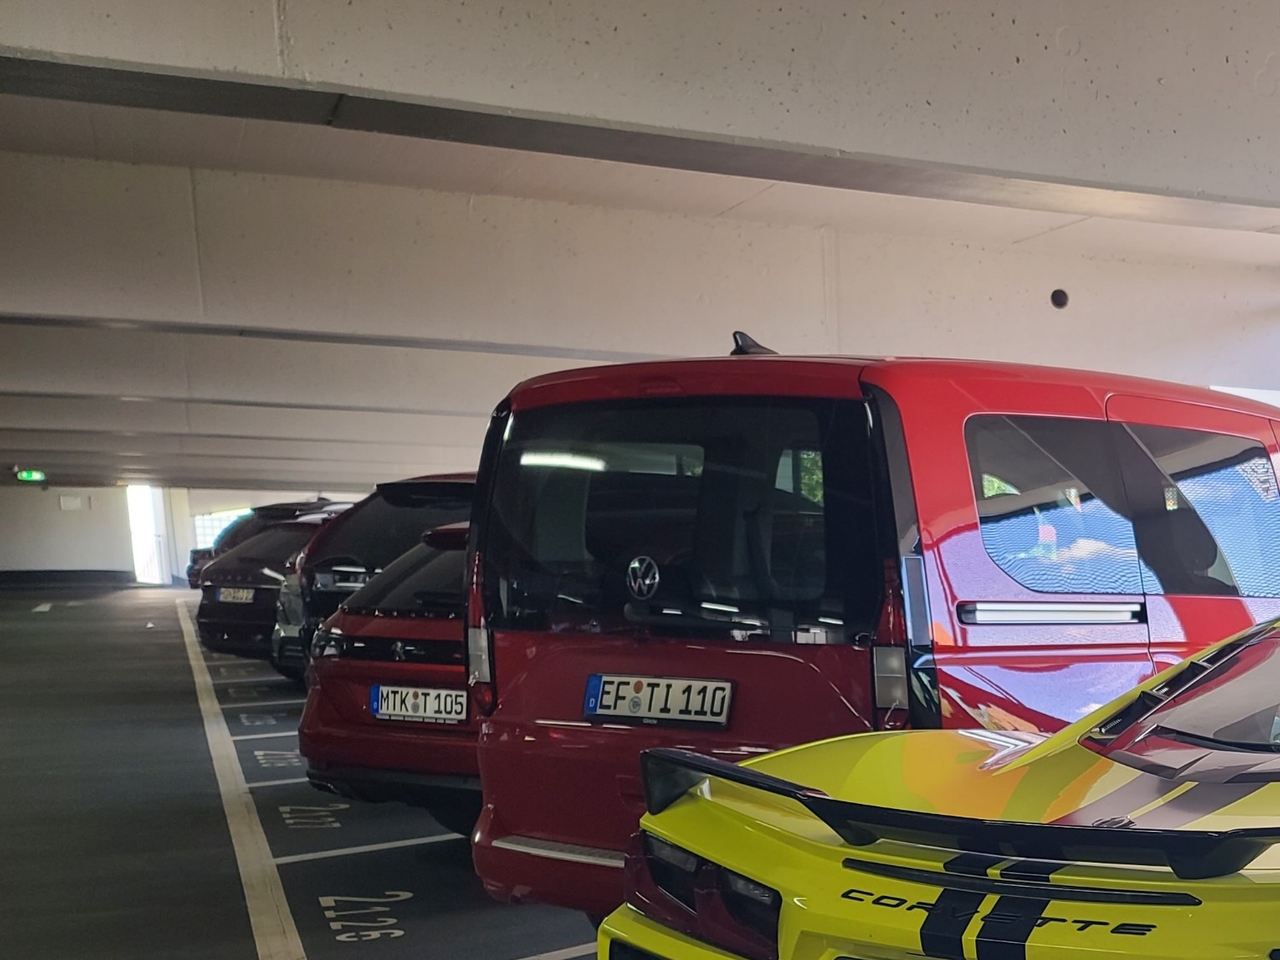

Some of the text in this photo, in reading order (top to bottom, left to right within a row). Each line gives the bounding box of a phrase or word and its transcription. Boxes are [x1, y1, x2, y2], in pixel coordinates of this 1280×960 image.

[380, 690, 409, 712] MTK
[421, 692, 430, 713] T
[434, 694, 464, 715] 105
[599, 681, 630, 710] EF
[647, 683, 672, 714] TI
[679, 685, 726, 717] 110
[318, 891, 414, 941] 2126
[841, 888, 1158, 936] CORVETTE
